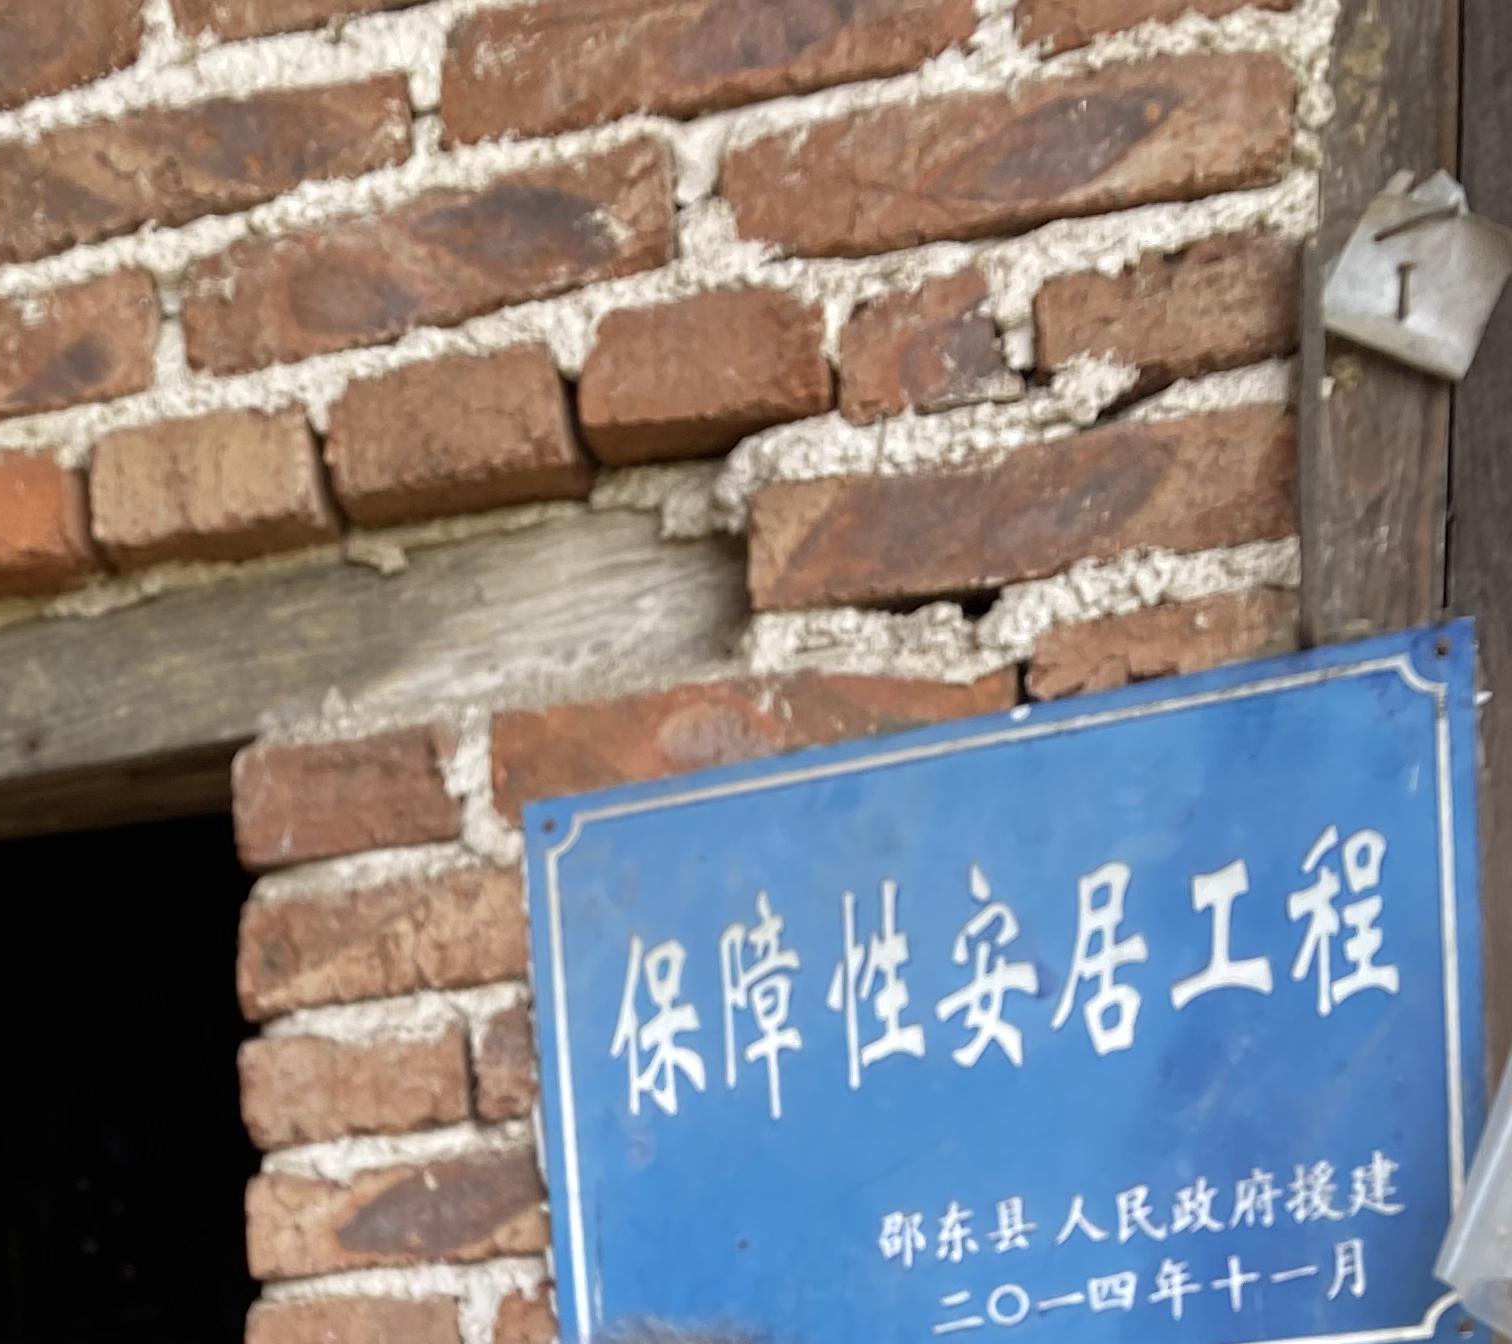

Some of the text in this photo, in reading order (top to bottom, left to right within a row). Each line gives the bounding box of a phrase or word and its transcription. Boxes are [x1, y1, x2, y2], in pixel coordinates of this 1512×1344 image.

[610, 824, 1400, 1119] 保障性安居工程
[878, 1150, 1406, 1269] 邵东县人民政府援建
